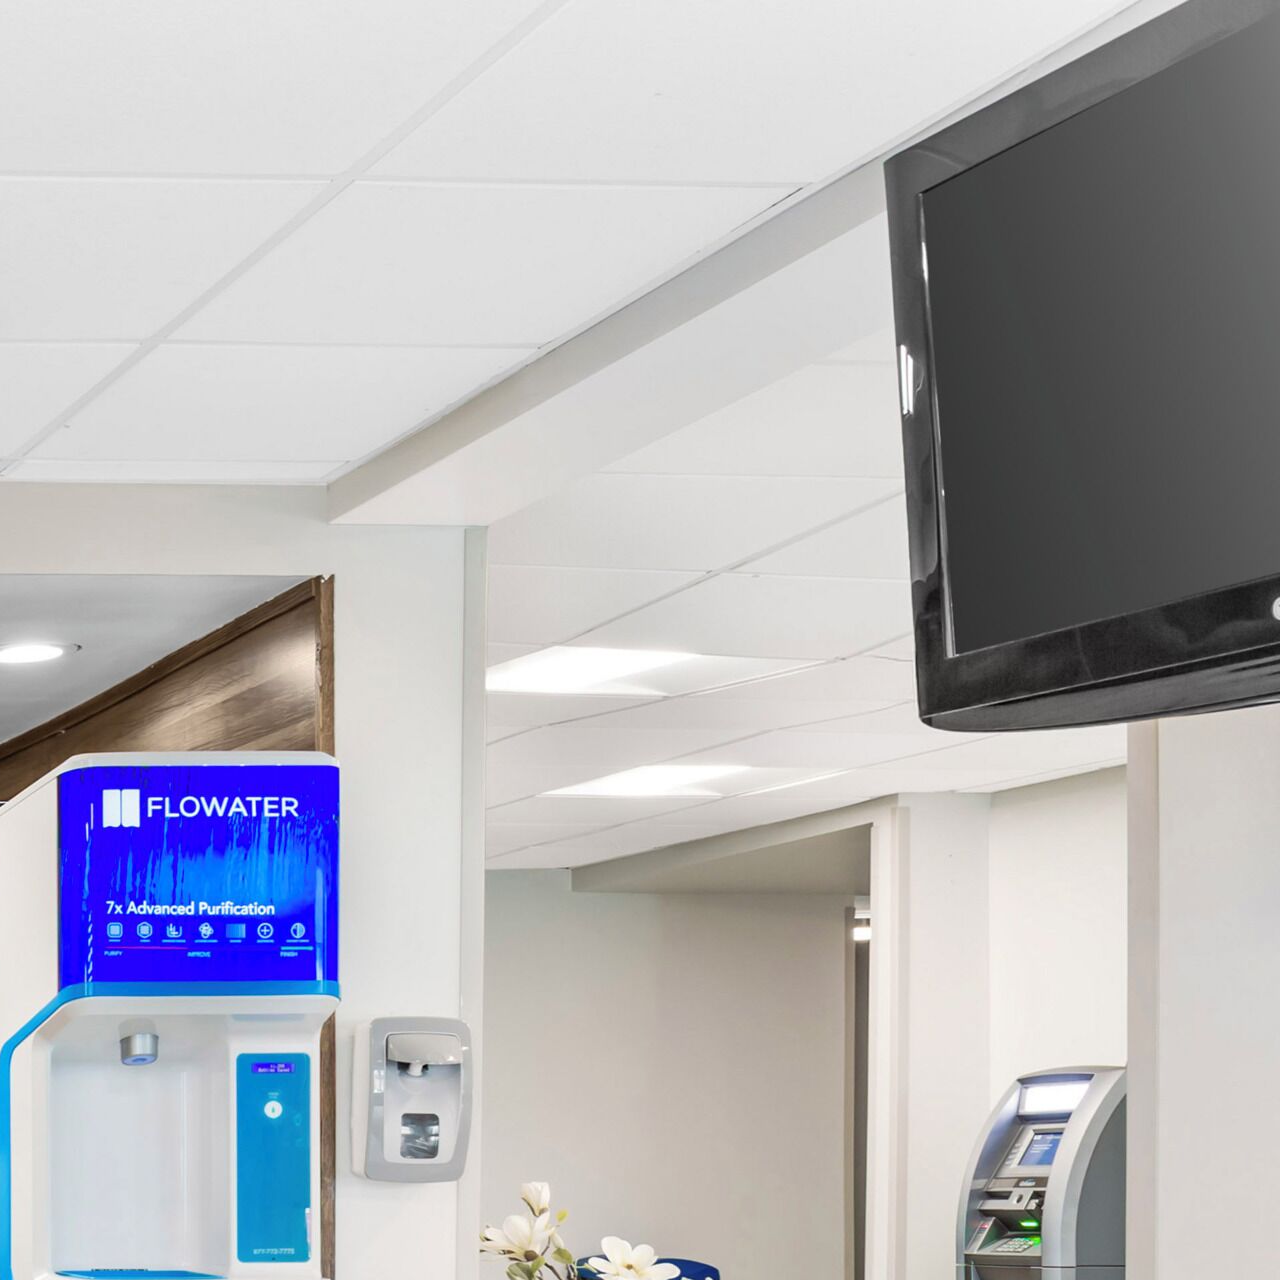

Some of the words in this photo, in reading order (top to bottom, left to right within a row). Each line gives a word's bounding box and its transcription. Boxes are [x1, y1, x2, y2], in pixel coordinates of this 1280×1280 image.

[147, 796, 299, 818] FLOWATER
[105, 900, 123, 915] 7x
[126, 900, 195, 916] Advanced
[198, 900, 276, 916] Purification
